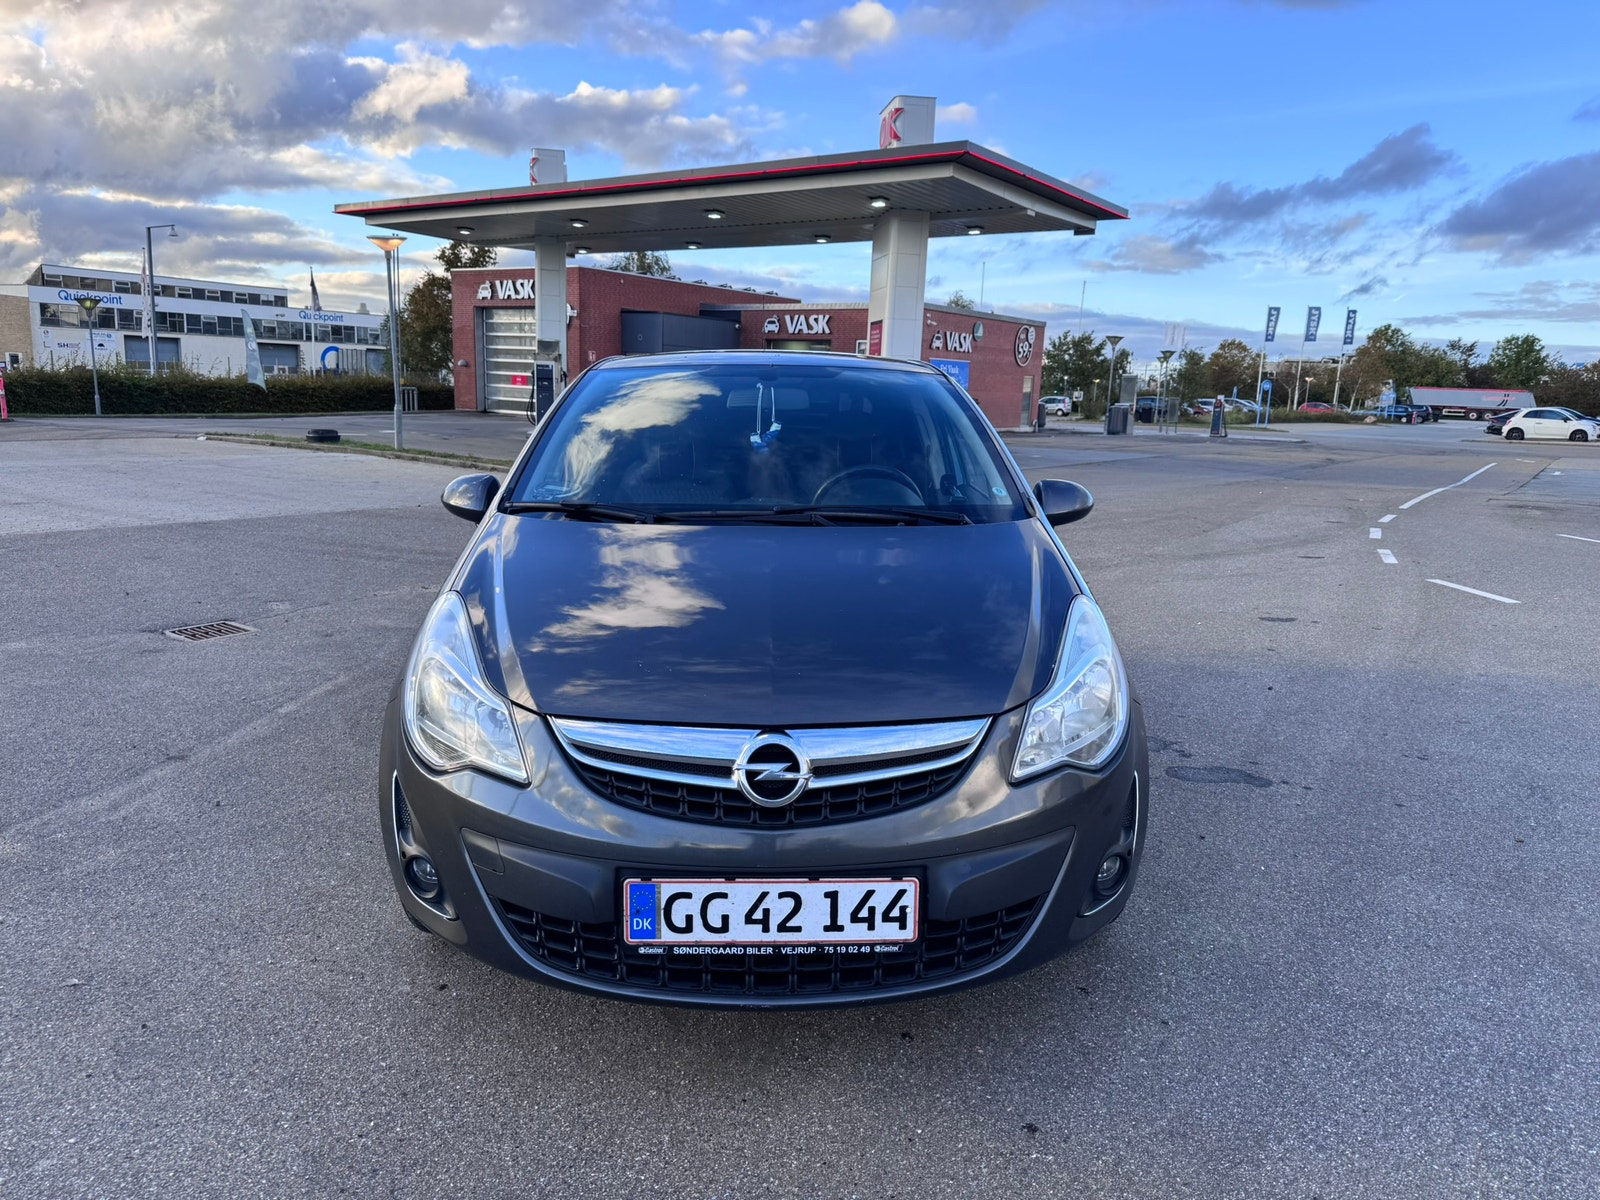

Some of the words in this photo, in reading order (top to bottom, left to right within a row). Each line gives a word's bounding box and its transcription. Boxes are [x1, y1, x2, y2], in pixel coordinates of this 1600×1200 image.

[495, 279, 535, 299] VASK
[299, 310, 344, 323] Quckpoint
[784, 314, 831, 334] VASK
[1267, 308, 1278, 336] JYSK
[1309, 308, 1320, 337] JYSK
[1345, 311, 1355, 338] JYSK
[945, 331, 973, 353] VASK
[663, 891, 730, 934] GG
[744, 890, 803, 933] 42
[823, 888, 909, 932] 144
[633, 918, 652, 930] DK
[673, 946, 745, 955] SØNDERGAARD
[746, 947, 774, 955] BILER
[780, 946, 817, 955] VEJRUP
[823, 946, 834, 954] 75
[837, 945, 846, 953] 19
[848, 945, 858, 953] 02
[860, 945, 871, 953] 49
